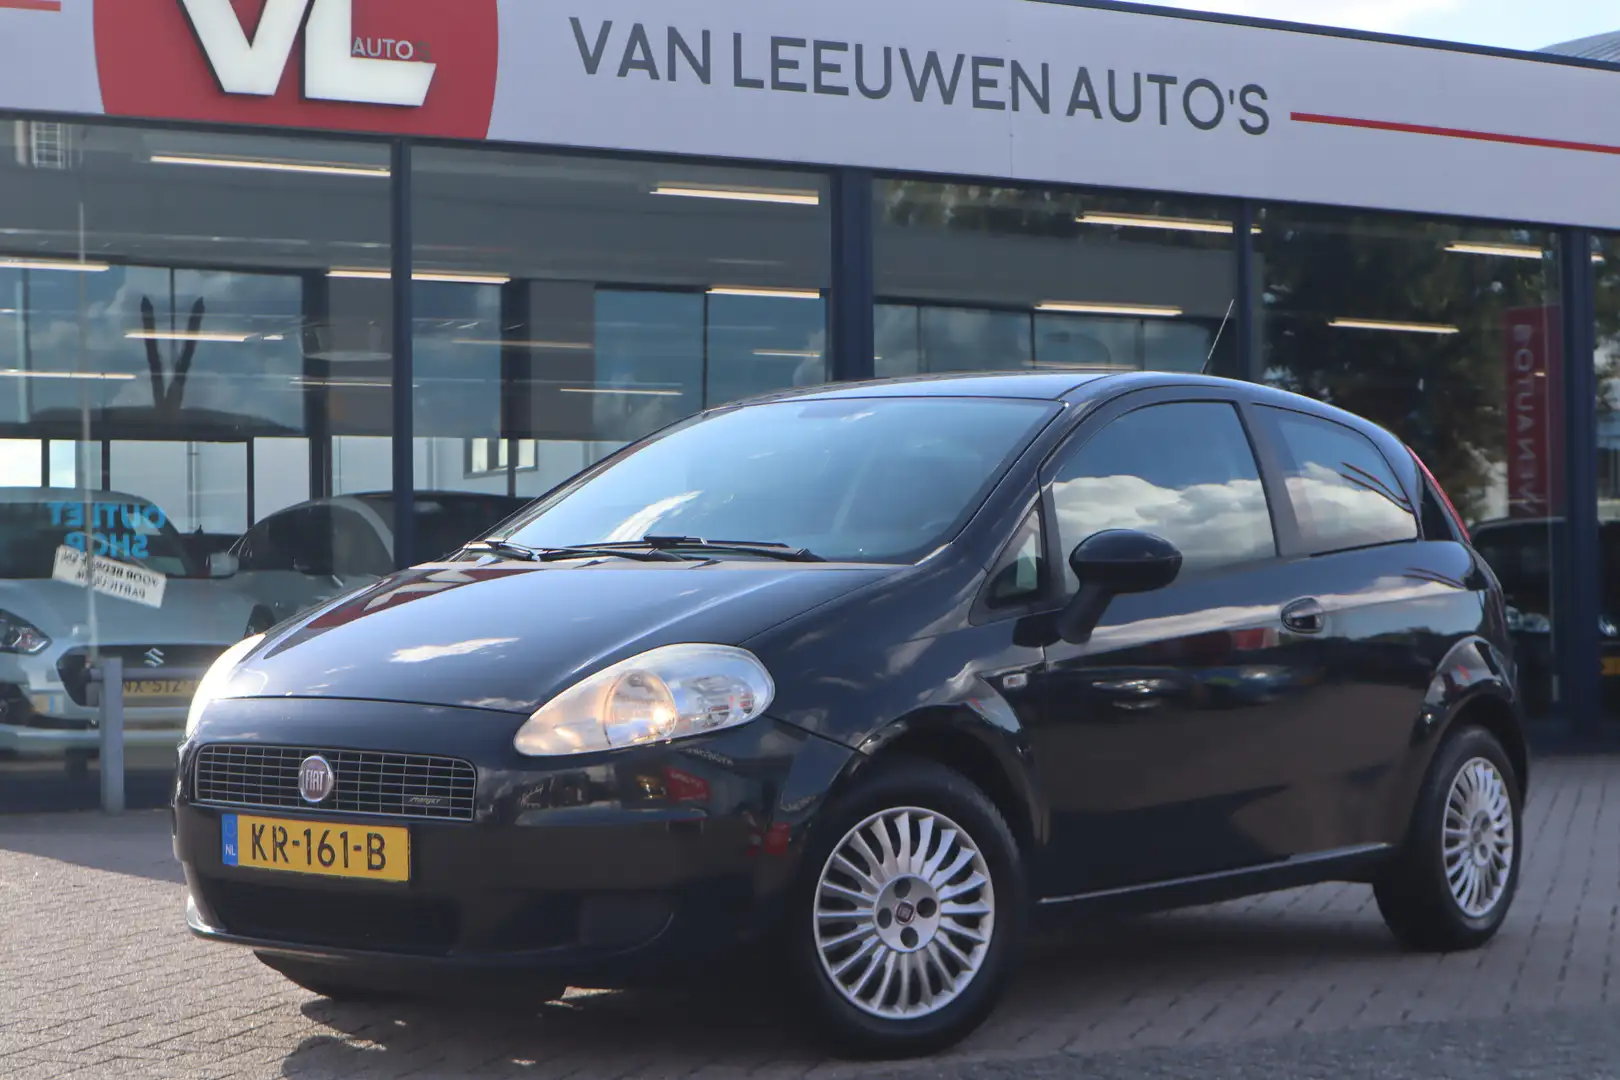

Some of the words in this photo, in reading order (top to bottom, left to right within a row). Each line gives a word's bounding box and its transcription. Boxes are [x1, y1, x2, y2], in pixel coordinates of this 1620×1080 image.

[569, 16, 711, 85] VAN
[733, 32, 1051, 115] LEEUWEN
[1065, 66, 1270, 136] AUTO'S
[305, 769, 325, 791] FIAT
[225, 843, 236, 857] NL
[251, 823, 386, 871] KR-161-B
